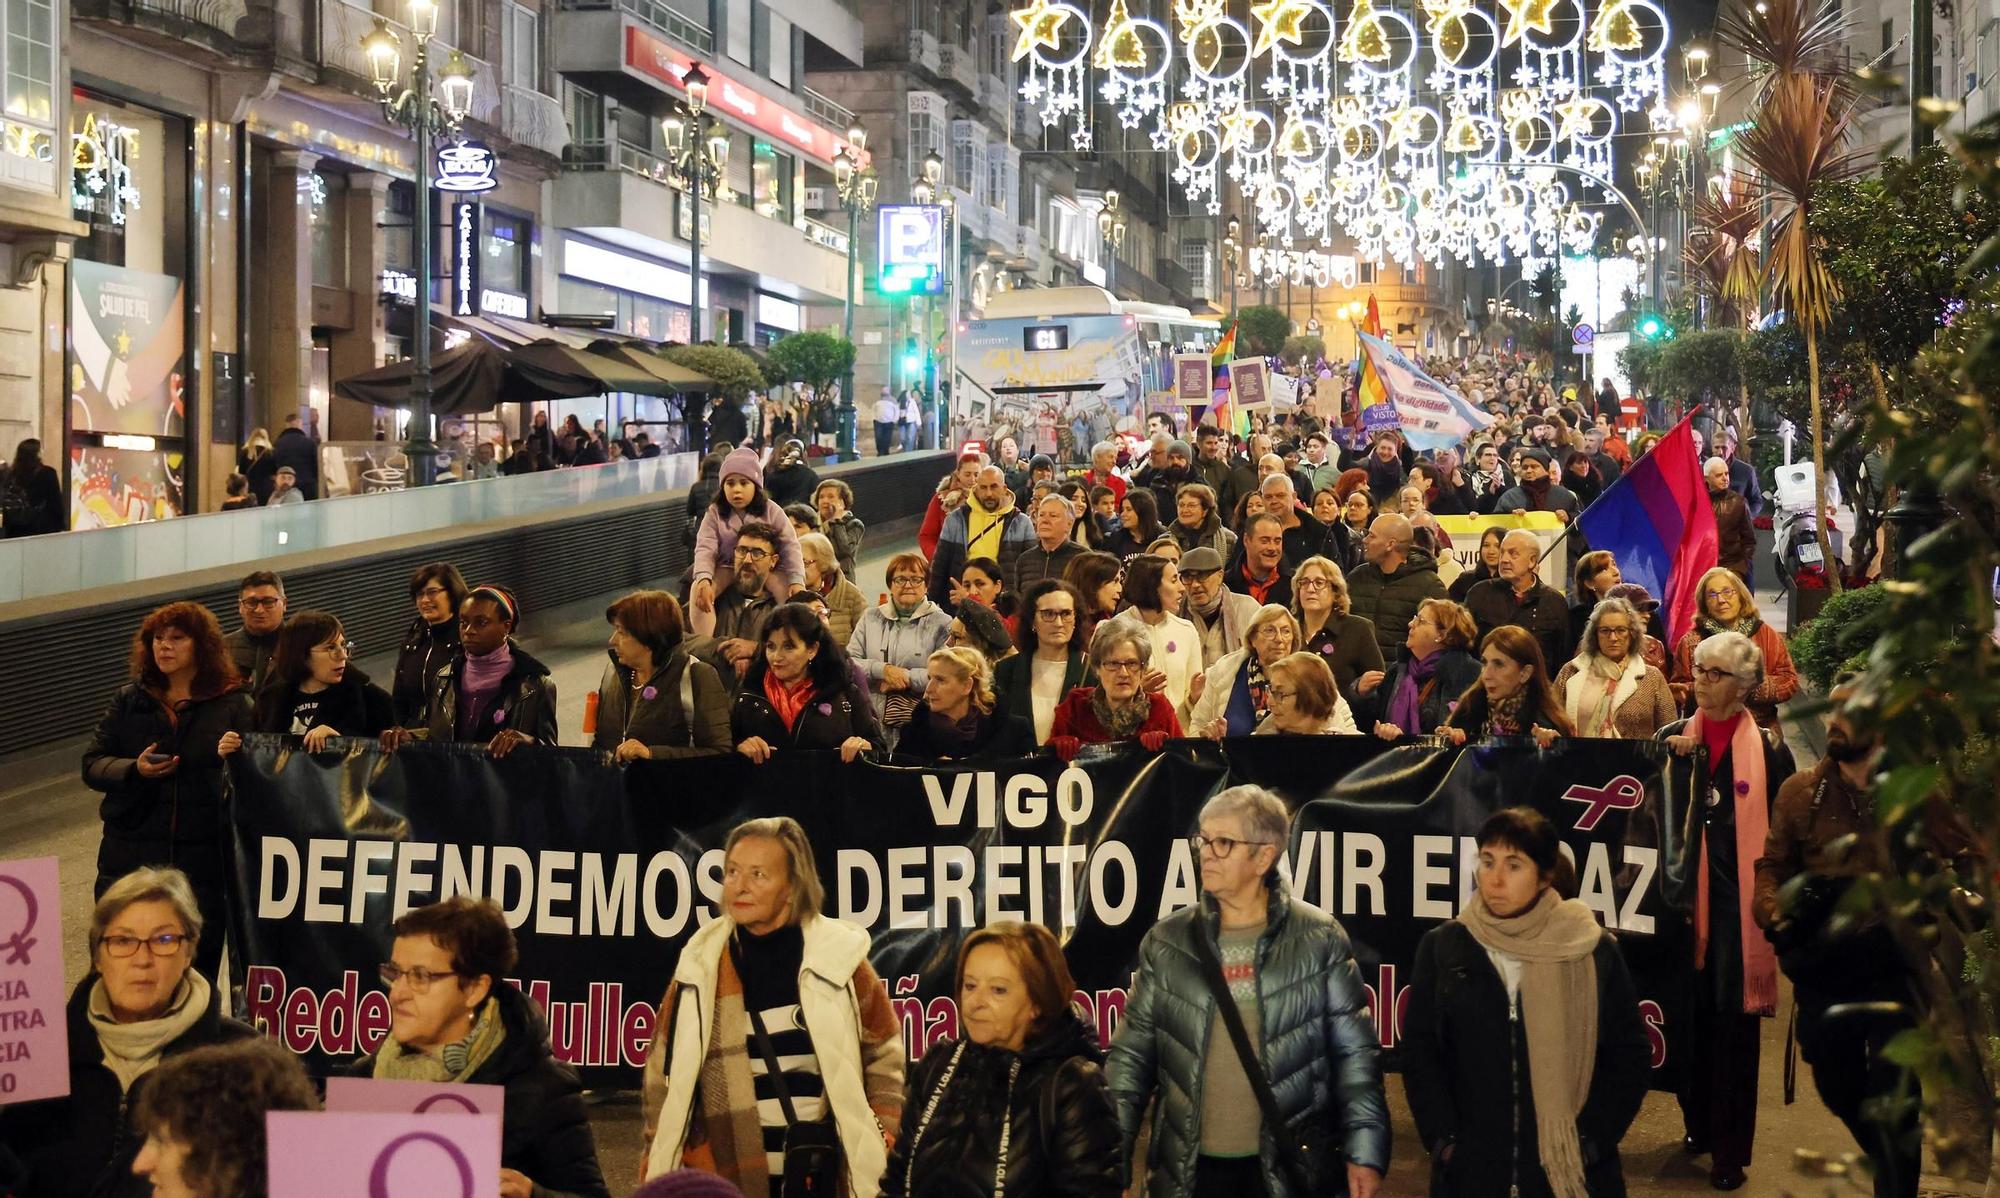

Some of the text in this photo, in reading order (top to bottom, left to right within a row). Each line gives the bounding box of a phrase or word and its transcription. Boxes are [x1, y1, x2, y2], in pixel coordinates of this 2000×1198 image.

[890, 213, 932, 262] P
[1035, 329, 1058, 349] C1
[1372, 410, 1396, 419] VISTO
[922, 767, 1094, 829] VIGO
[258, 835, 728, 938] DEFENDEMOS
[837, 840, 1138, 930] DEREITO
[246, 965, 392, 1055] Rede
[938, 1065, 956, 1087] LOLA
[995, 1162, 1007, 1189] LOLA
